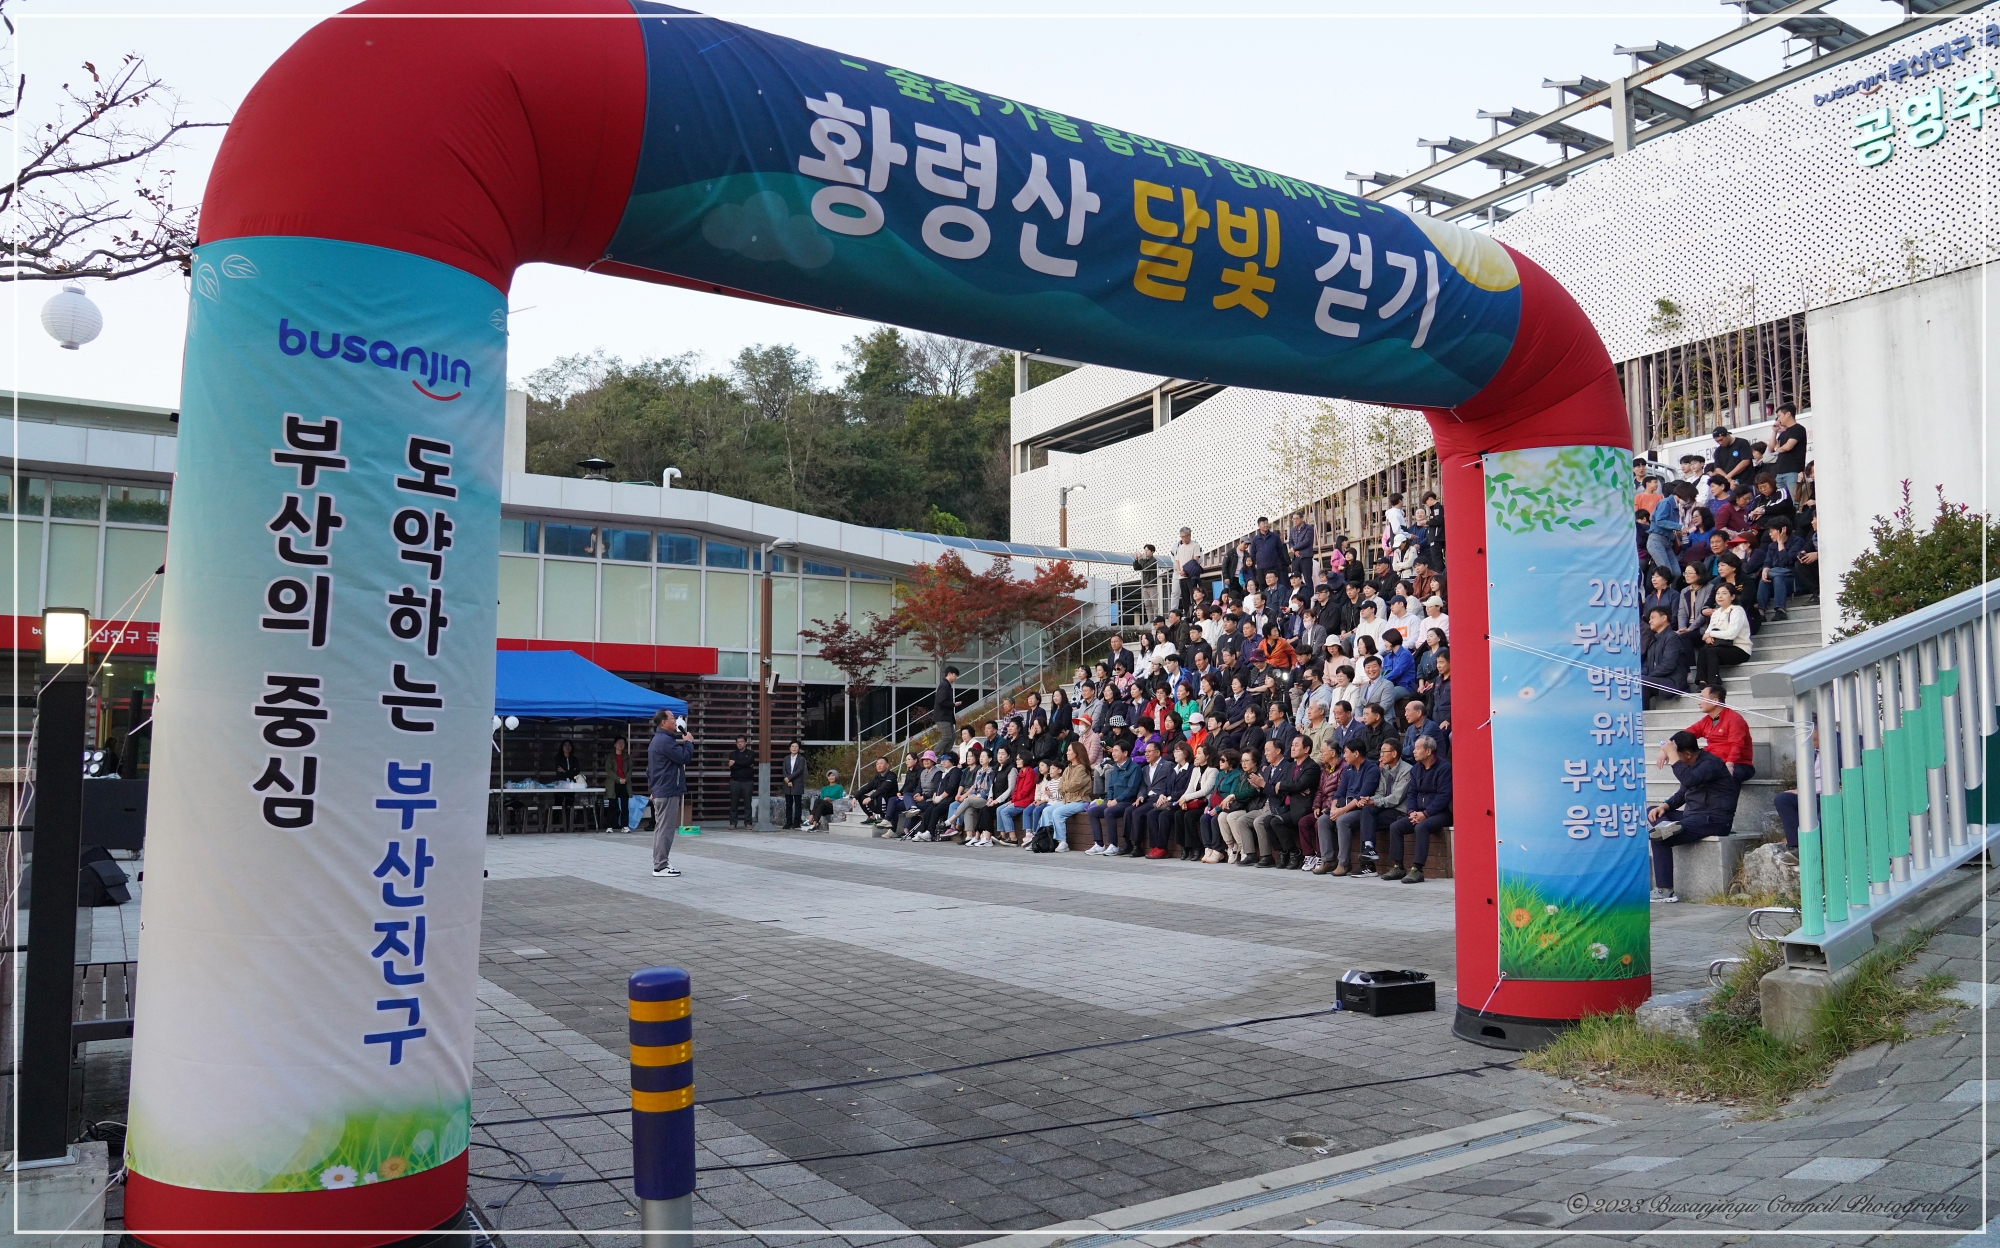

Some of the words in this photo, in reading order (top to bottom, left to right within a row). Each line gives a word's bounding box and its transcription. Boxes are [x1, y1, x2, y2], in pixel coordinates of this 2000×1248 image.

[1813, 71, 1887, 107] busanjin
[1888, 34, 1973, 84] 부산진구
[1850, 69, 2000, 168] 공영주
[884, 68, 981, 116] 숲속
[988, 95, 1084, 143] 가을
[1091, 123, 1212, 177] 음악과
[1210, 156, 1361, 217] 함께하는
[797, 91, 1101, 278] 황령산
[1133, 178, 1281, 319] 달빛
[1314, 225, 1440, 349] 걷기
[278, 317, 471, 388] busanjin
[260, 414, 348, 649] 부산의
[380, 435, 458, 734] 도약하는
[90, 629, 140, 645] 산진구
[251, 673, 330, 830] 중심
[1560, 757, 1646, 793] 부산진구
[1589, 711, 1644, 746] 유치를
[362, 759, 438, 1067] 부산진구
